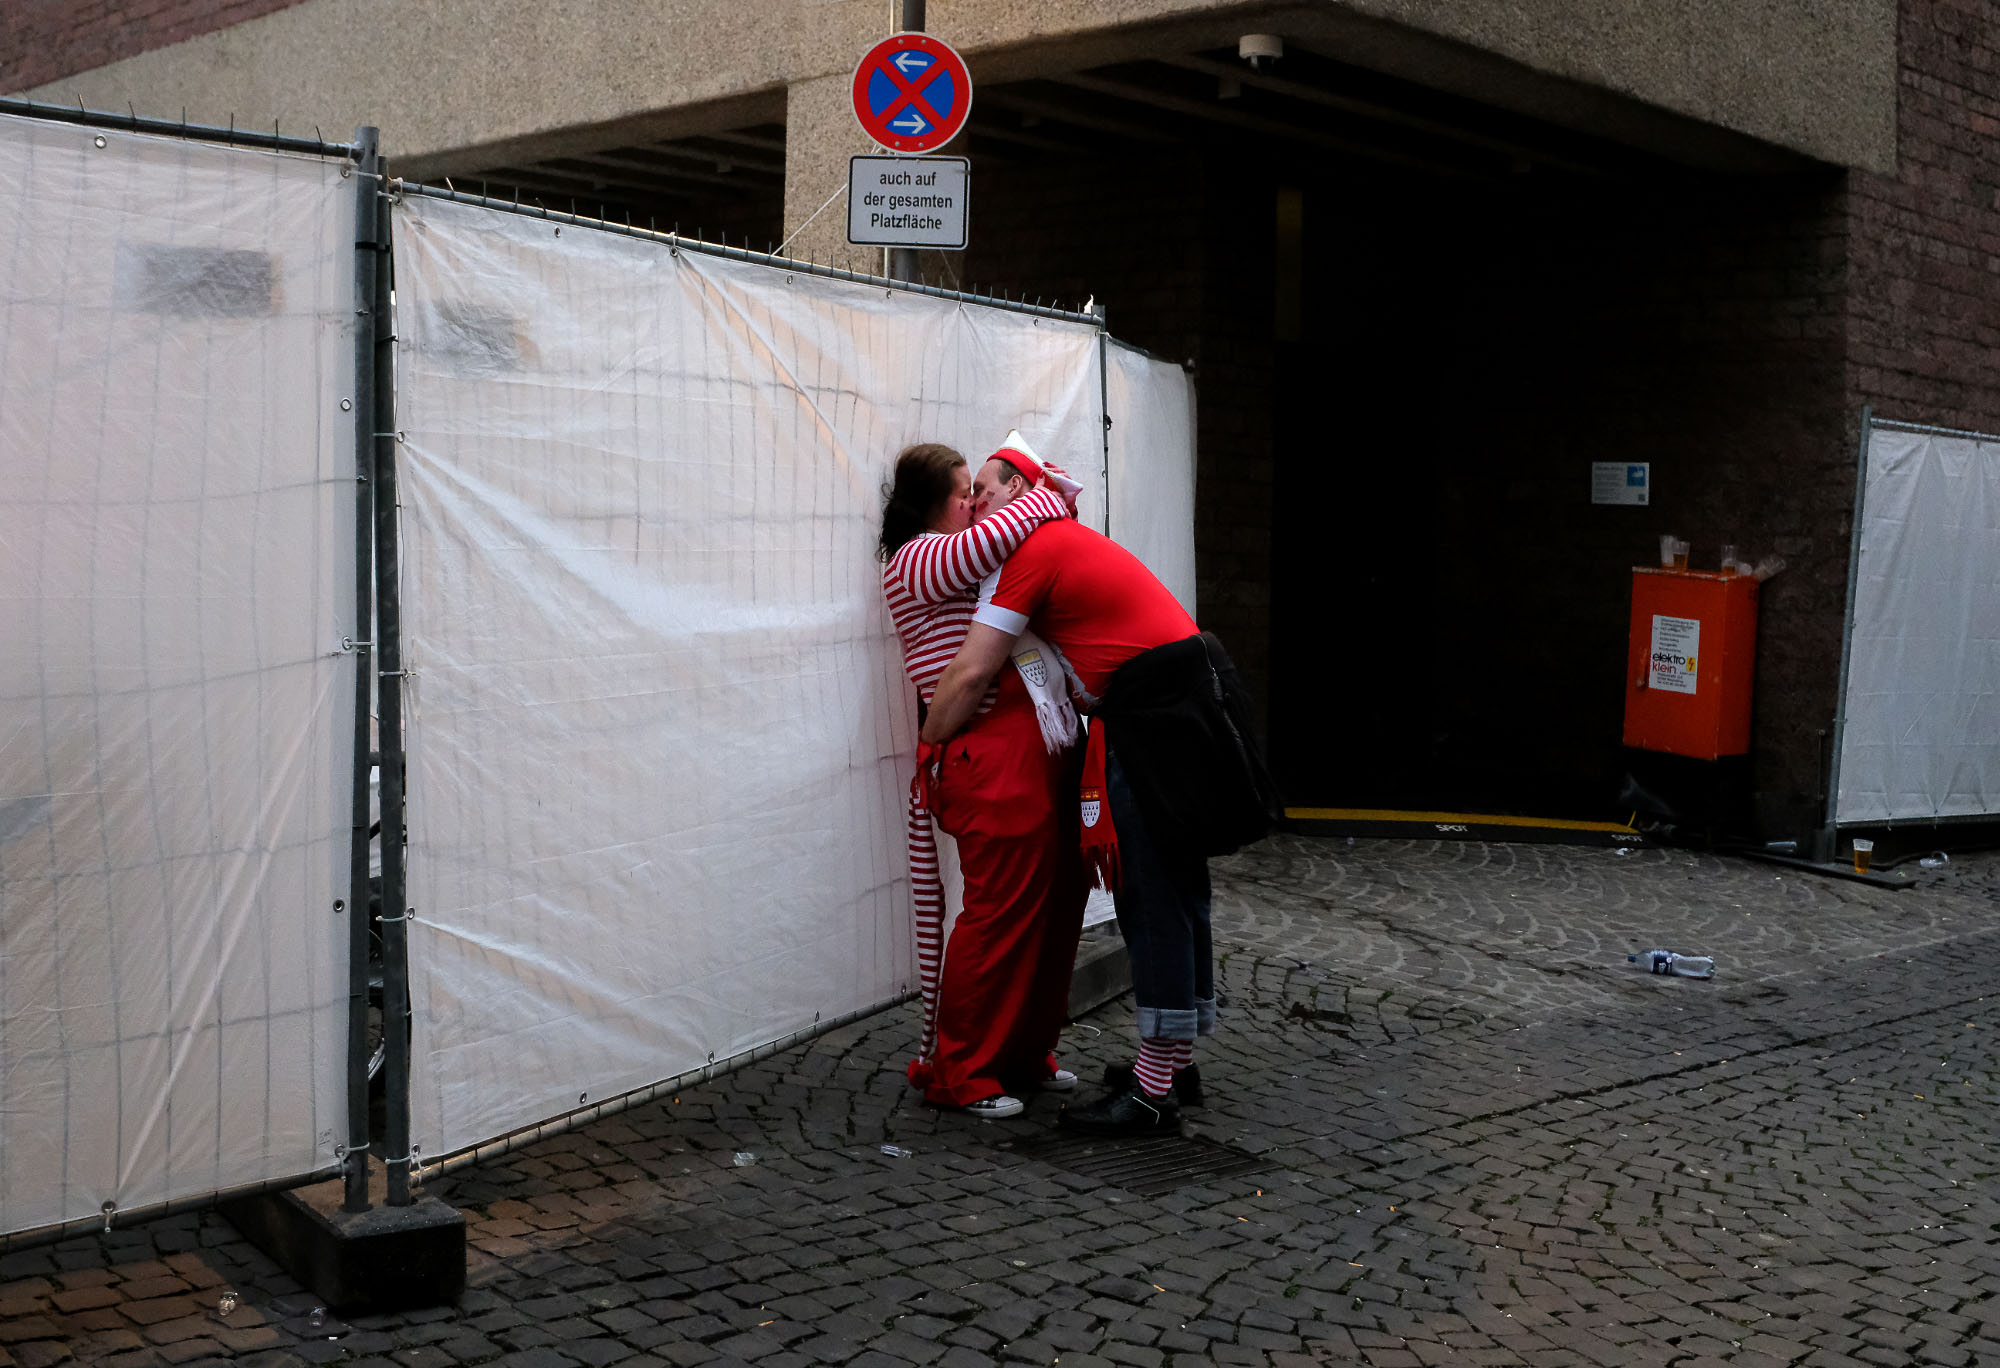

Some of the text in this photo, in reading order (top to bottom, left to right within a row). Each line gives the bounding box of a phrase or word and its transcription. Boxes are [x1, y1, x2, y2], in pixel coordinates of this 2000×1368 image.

[880, 171, 937, 186] auch auf
[864, 192, 953, 210] der gesamten
[871, 213, 942, 229] Platzfläche
[1652, 652, 1686, 665] elektro
[1652, 661, 1677, 674] klein
[1435, 824, 1468, 832] SPOT
